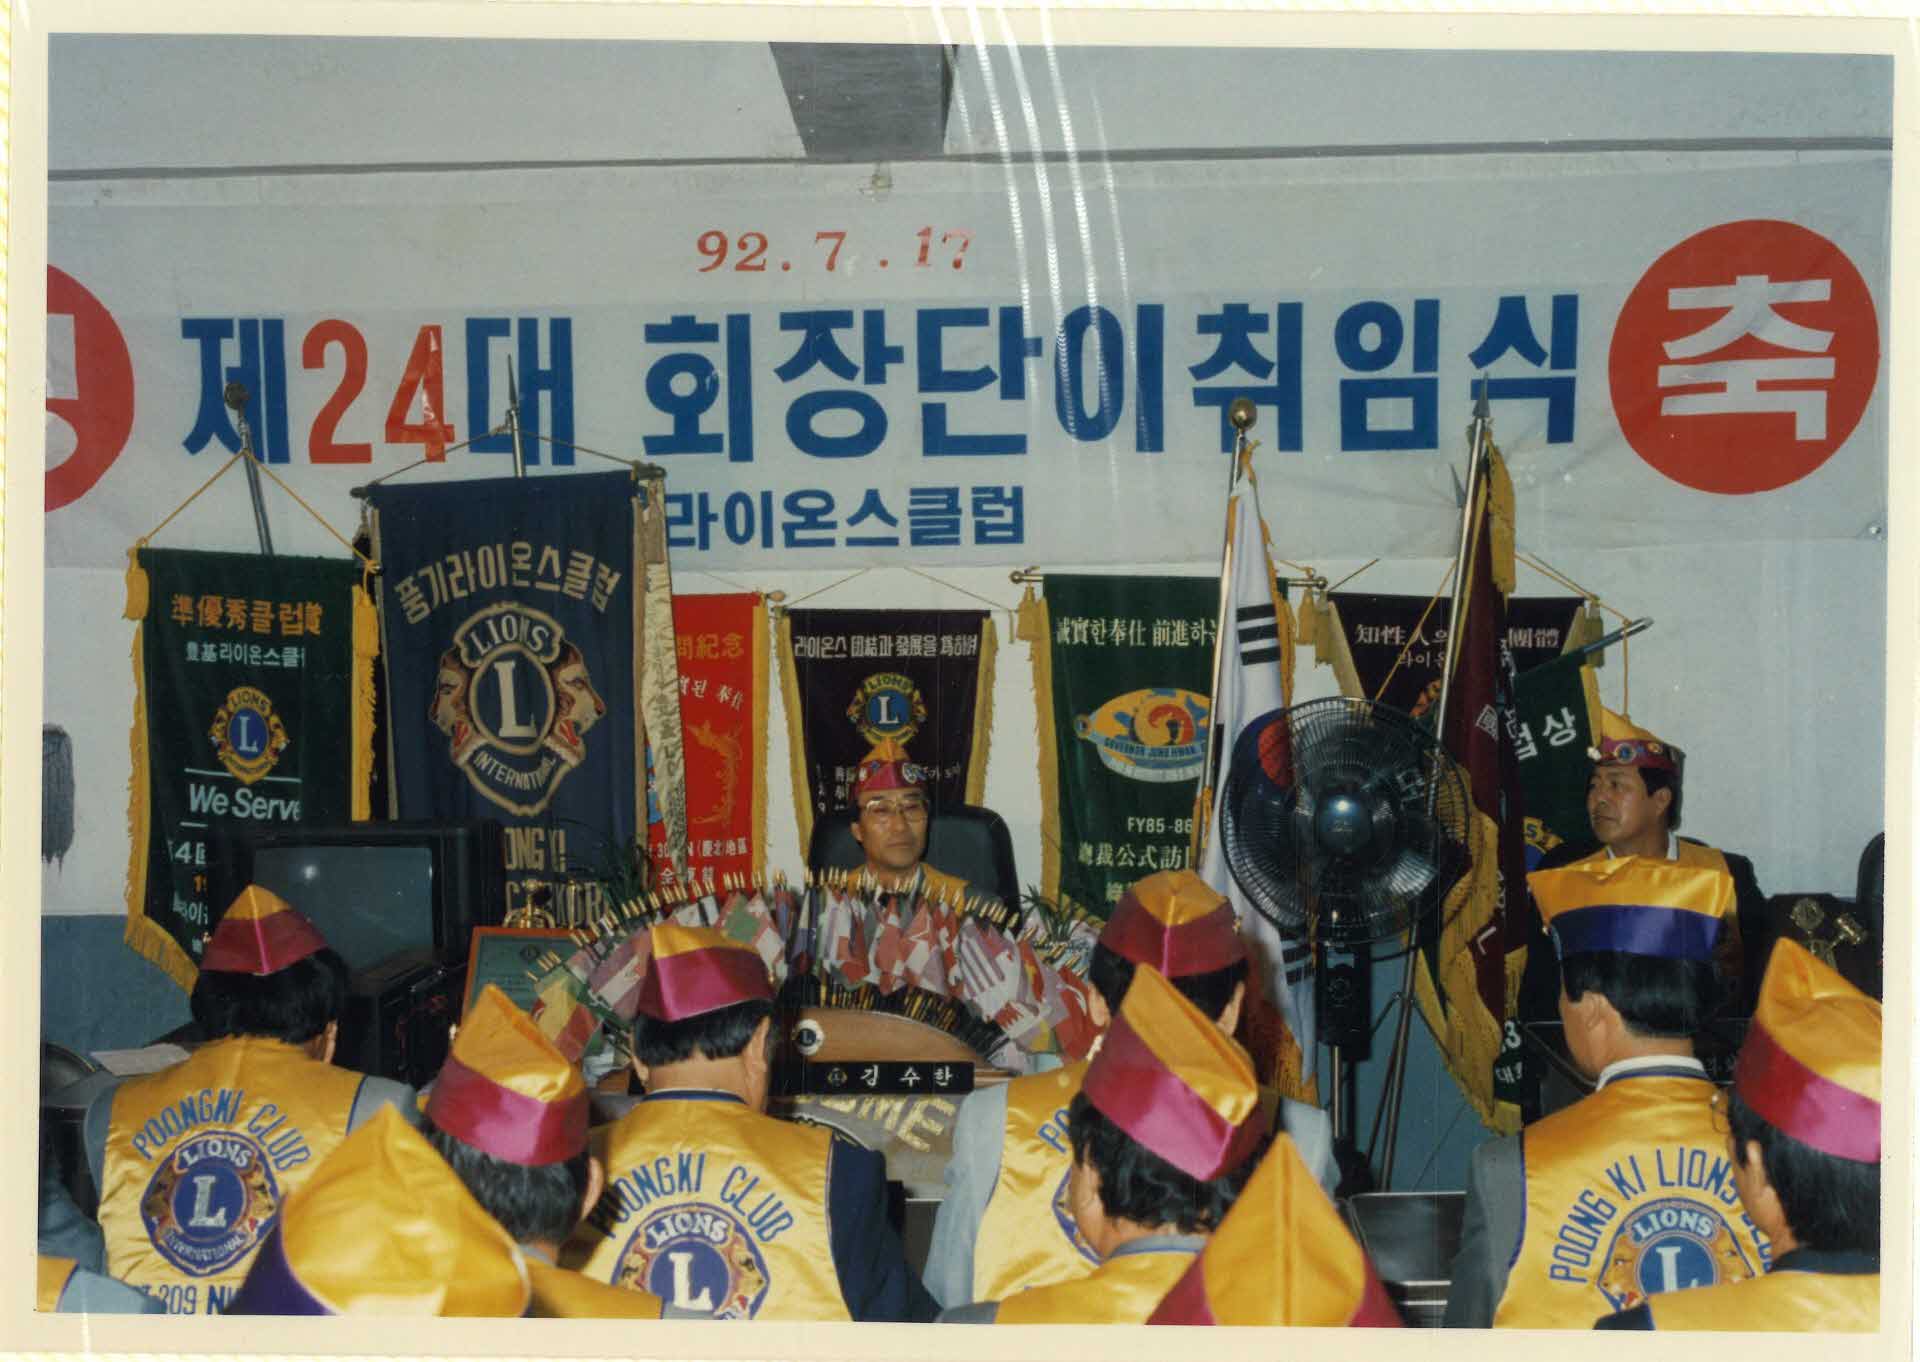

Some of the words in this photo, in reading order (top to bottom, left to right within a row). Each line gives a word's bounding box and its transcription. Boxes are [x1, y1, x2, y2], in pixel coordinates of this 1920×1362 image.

[1657, 273, 1837, 441] 축
[182, 315, 576, 465] 제24대
[470, 613, 549, 655] LIONS
[494, 659, 537, 739] L
[877, 695, 899, 725] L
[239, 715, 260, 753] L
[189, 783, 229, 815] We
[232, 787, 301, 822] Serve
[132, 1087, 244, 1160] POONGKI
[248, 1103, 311, 1171] CLUB
[182, 1139, 253, 1167] LIONS
[188, 1175, 227, 1228] L
[720, 1165, 794, 1242] CLUB
[1550, 1189, 1617, 1284] POONG
[1606, 1155, 1646, 1200] KI
[1633, 1207, 1716, 1240] LIONS
[646, 1211, 729, 1247] LIONS
[668, 1251, 714, 1311] L
[1655, 1245, 1700, 1294] L
